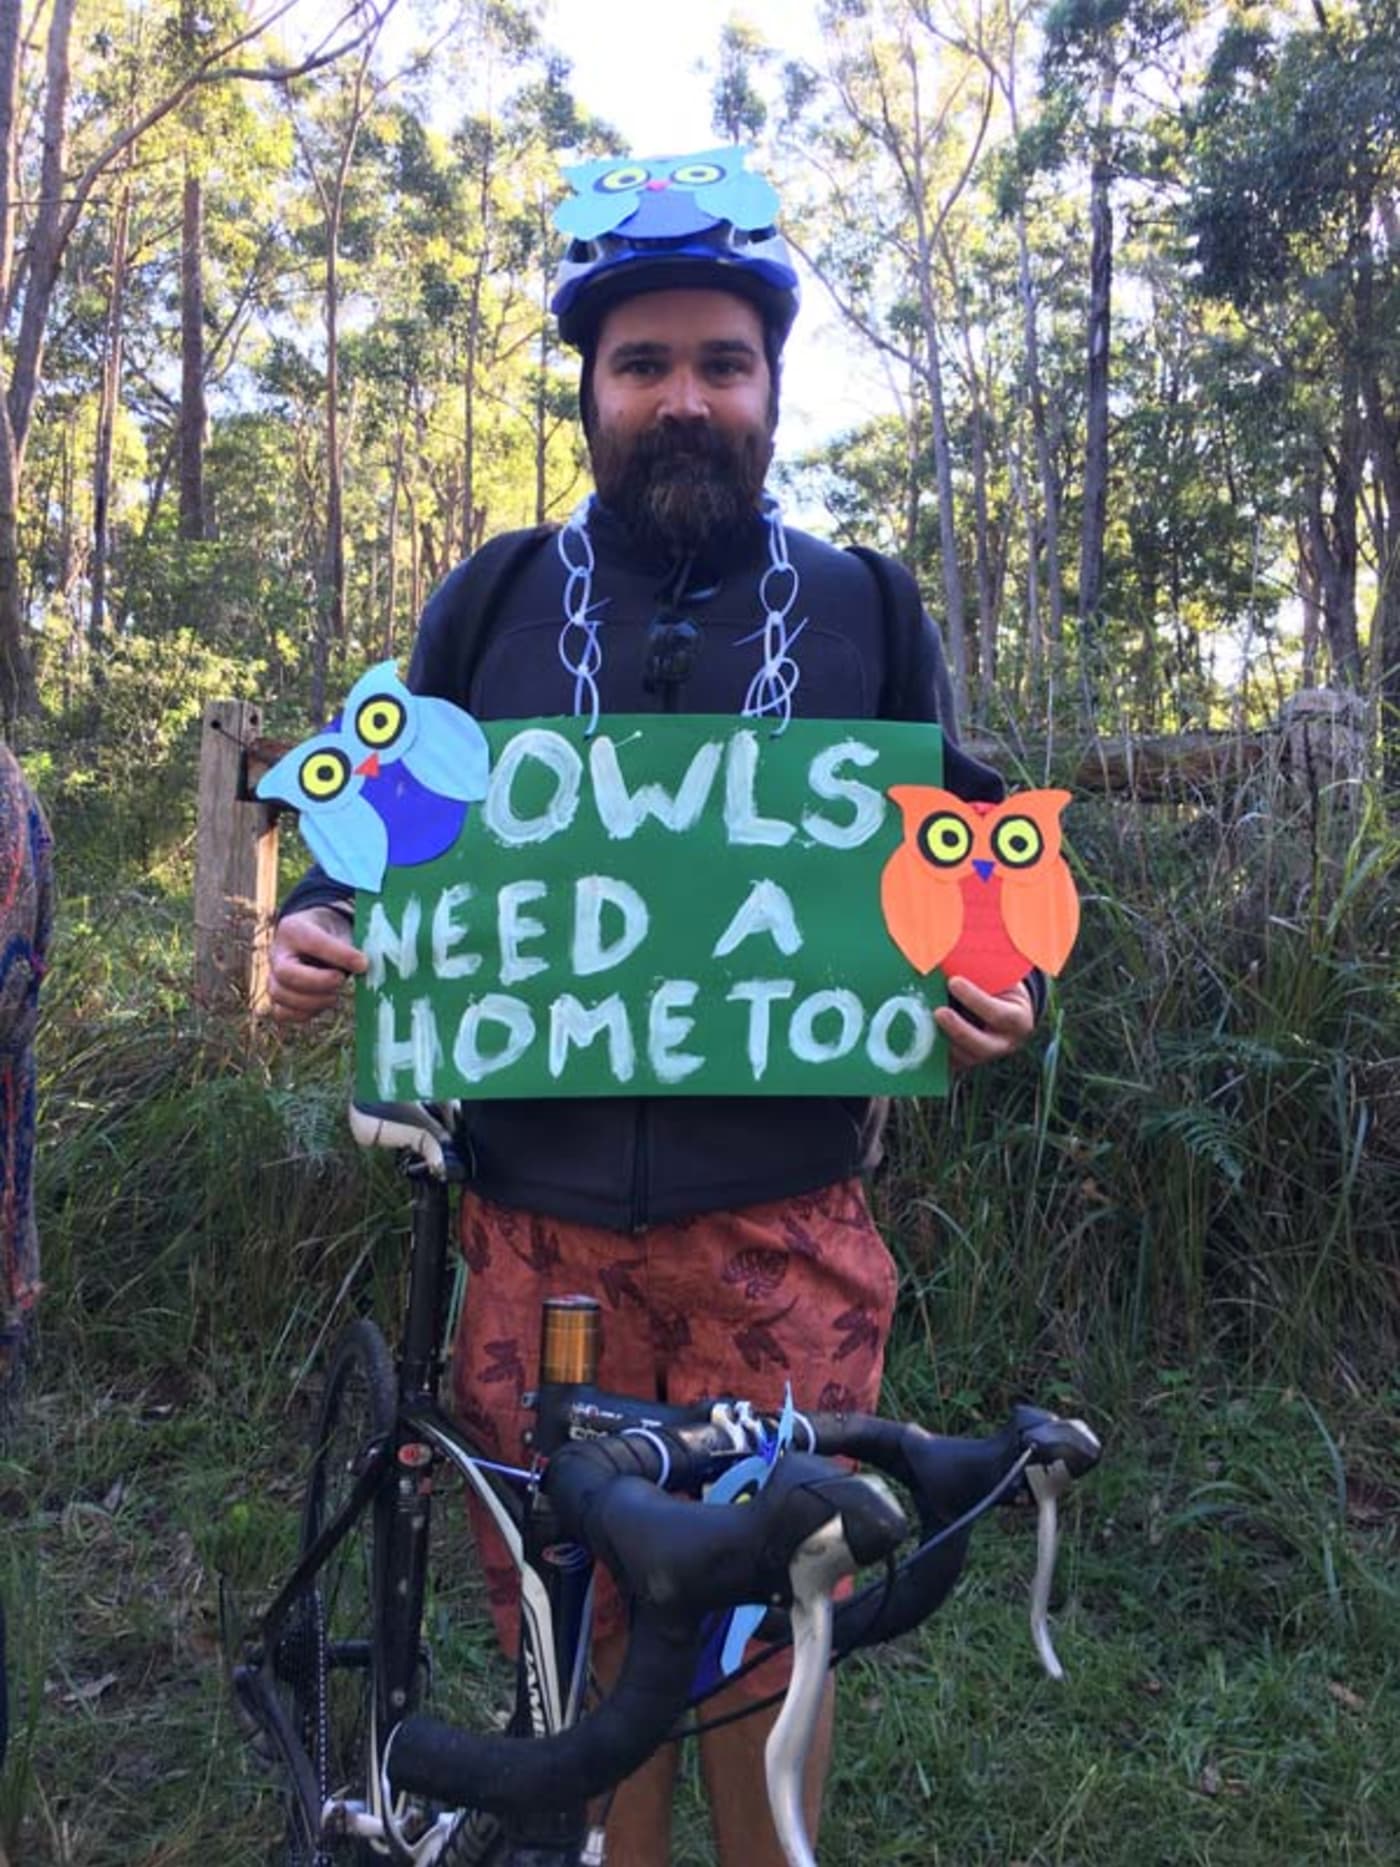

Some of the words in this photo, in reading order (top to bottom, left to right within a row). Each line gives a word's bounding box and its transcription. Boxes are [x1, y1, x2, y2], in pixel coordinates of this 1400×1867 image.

[483, 728, 886, 848] OWLS
[364, 874, 649, 988] NEED
[713, 878, 802, 958] A
[374, 979, 704, 1098] HOME
[727, 979, 934, 1080] TOO
